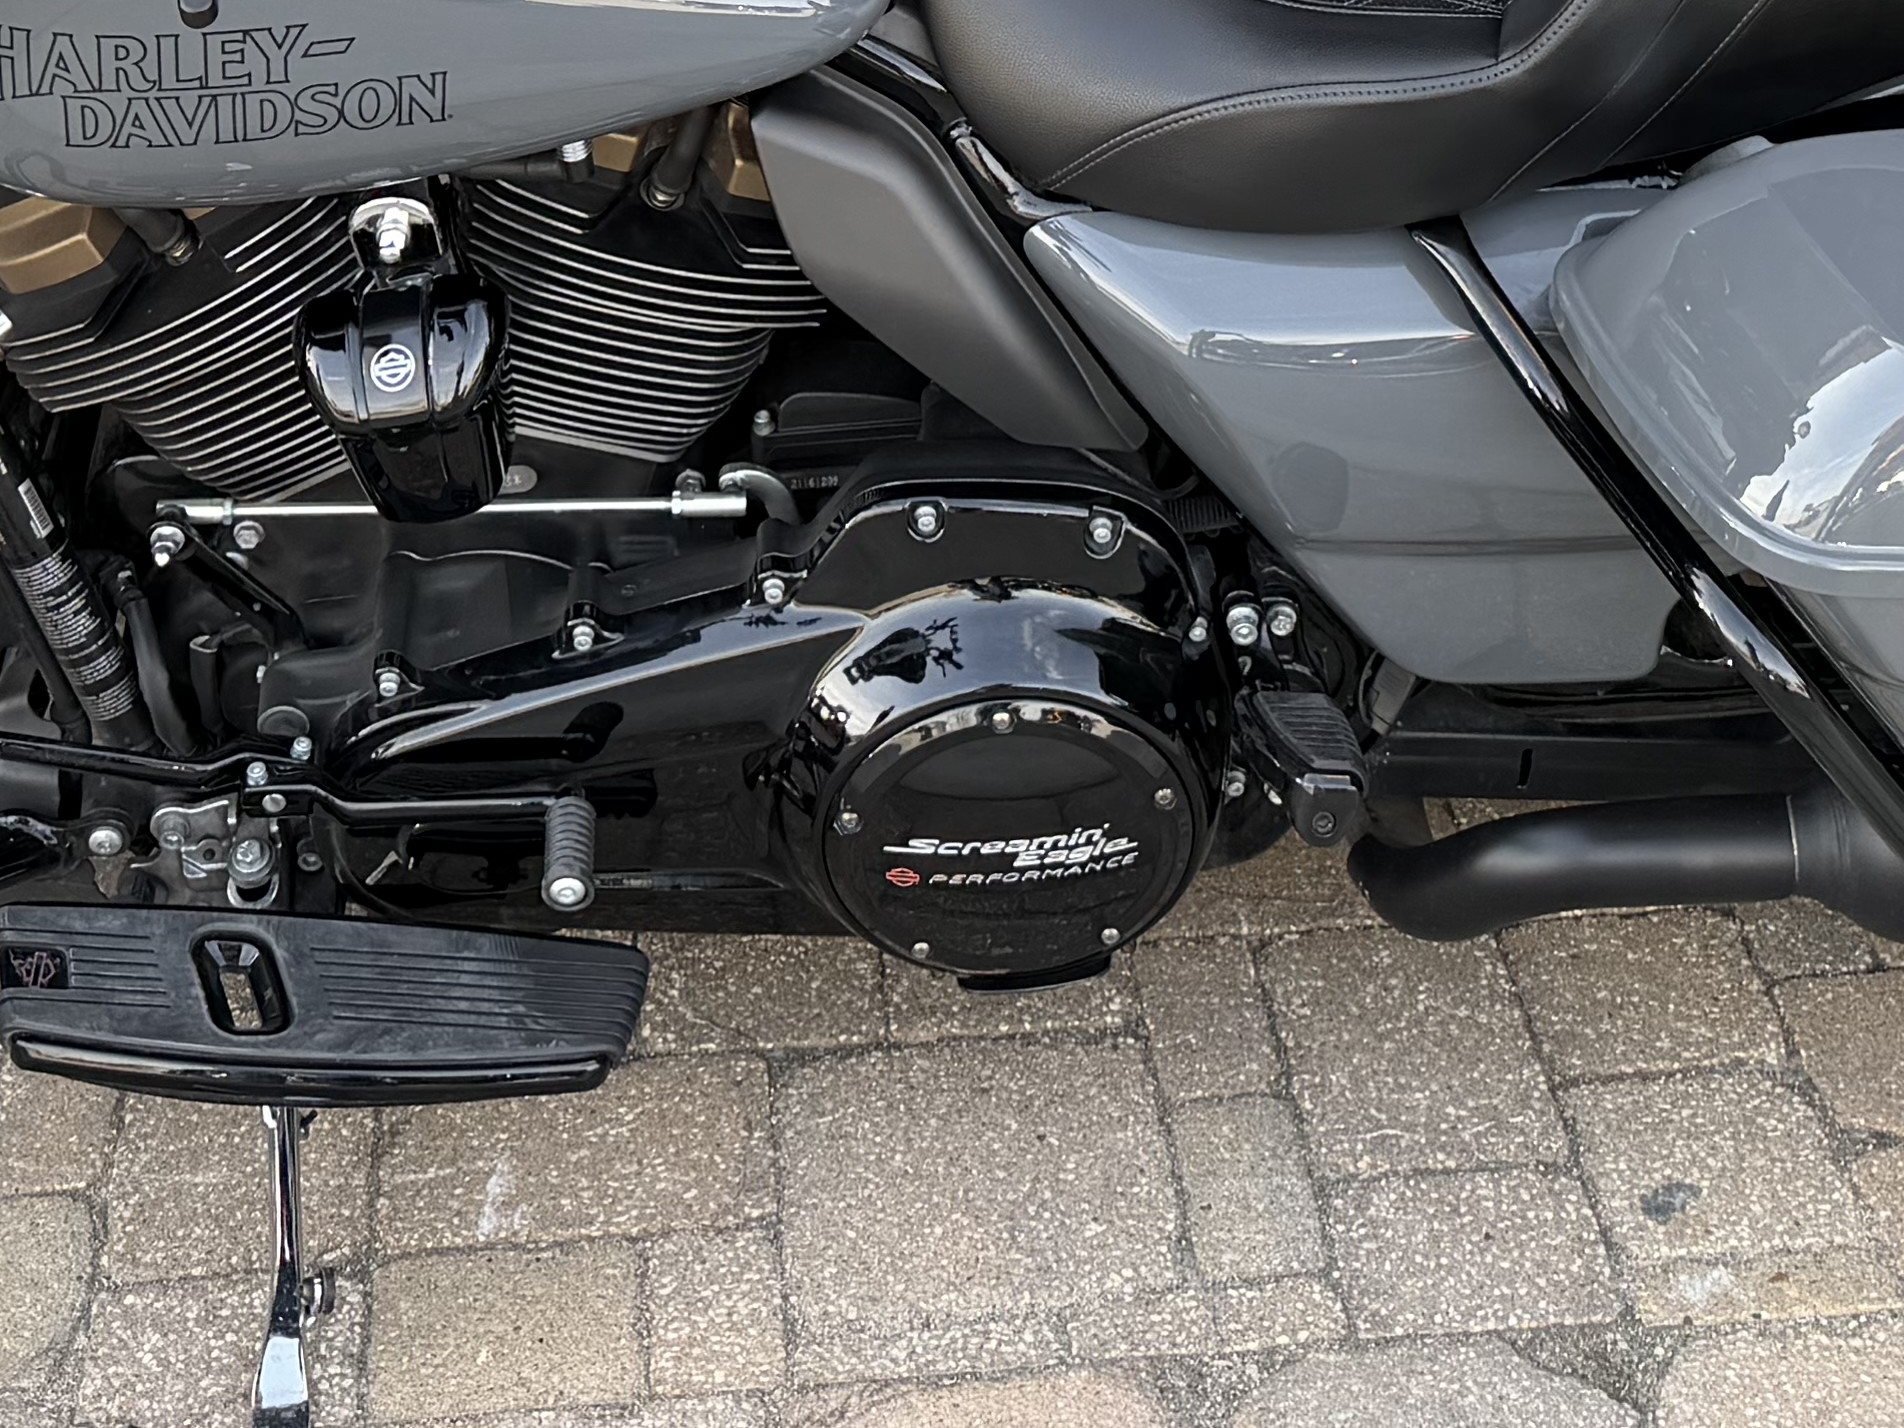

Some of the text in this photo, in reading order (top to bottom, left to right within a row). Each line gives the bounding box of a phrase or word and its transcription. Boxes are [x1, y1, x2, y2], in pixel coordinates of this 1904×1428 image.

[61, 70, 448, 149] DAVIDSON
[929, 851, 1139, 885] PERFORMANCE
[1013, 835, 1138, 868] Eagle
